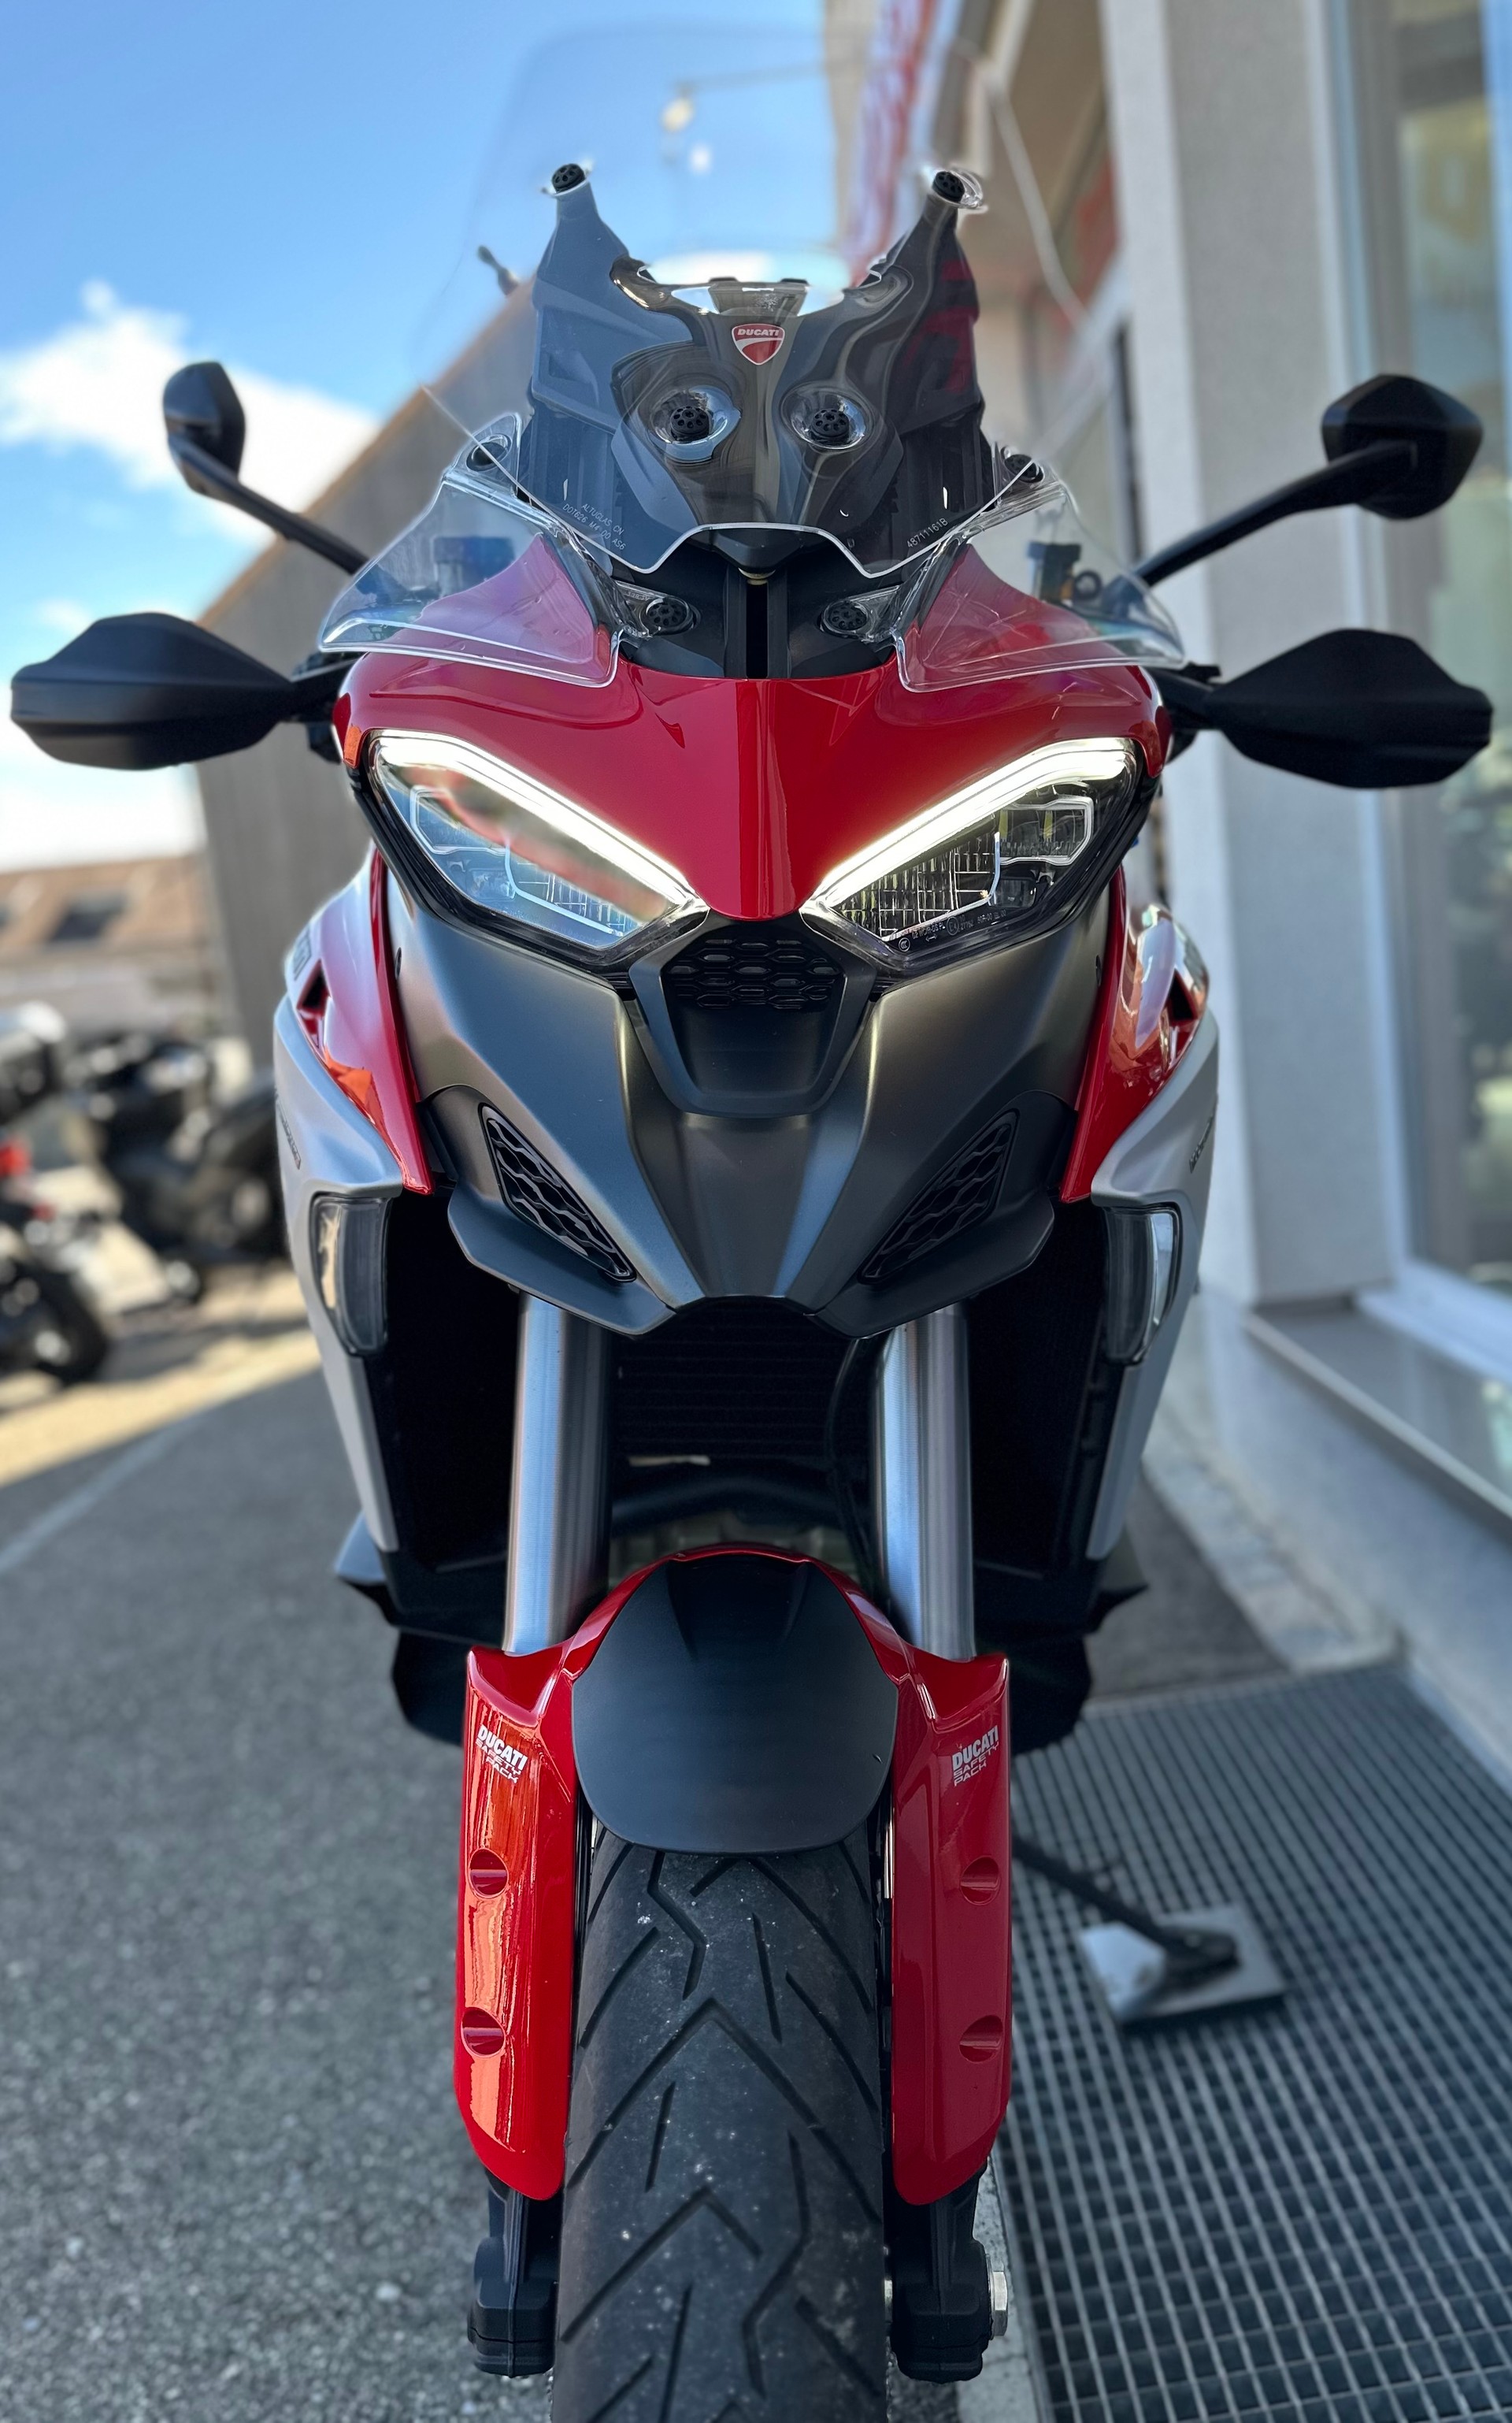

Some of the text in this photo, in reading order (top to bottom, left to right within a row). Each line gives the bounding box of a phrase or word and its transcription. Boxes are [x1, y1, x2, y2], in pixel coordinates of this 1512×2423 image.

[562, 503, 588, 523] DOT626
[612, 538, 626, 550] AS6
[582, 503, 624, 535] ALTUGLAS CN
[906, 518, 948, 547] 48711161B
[475, 1738, 521, 1776] SAFETY
[476, 1724, 528, 1772] DUCATI
[952, 1724, 999, 1772] DUCATI
[953, 1741, 999, 1779] SAFETY
[485, 1756, 519, 1783] PACK
[954, 1759, 987, 1787] PACK
